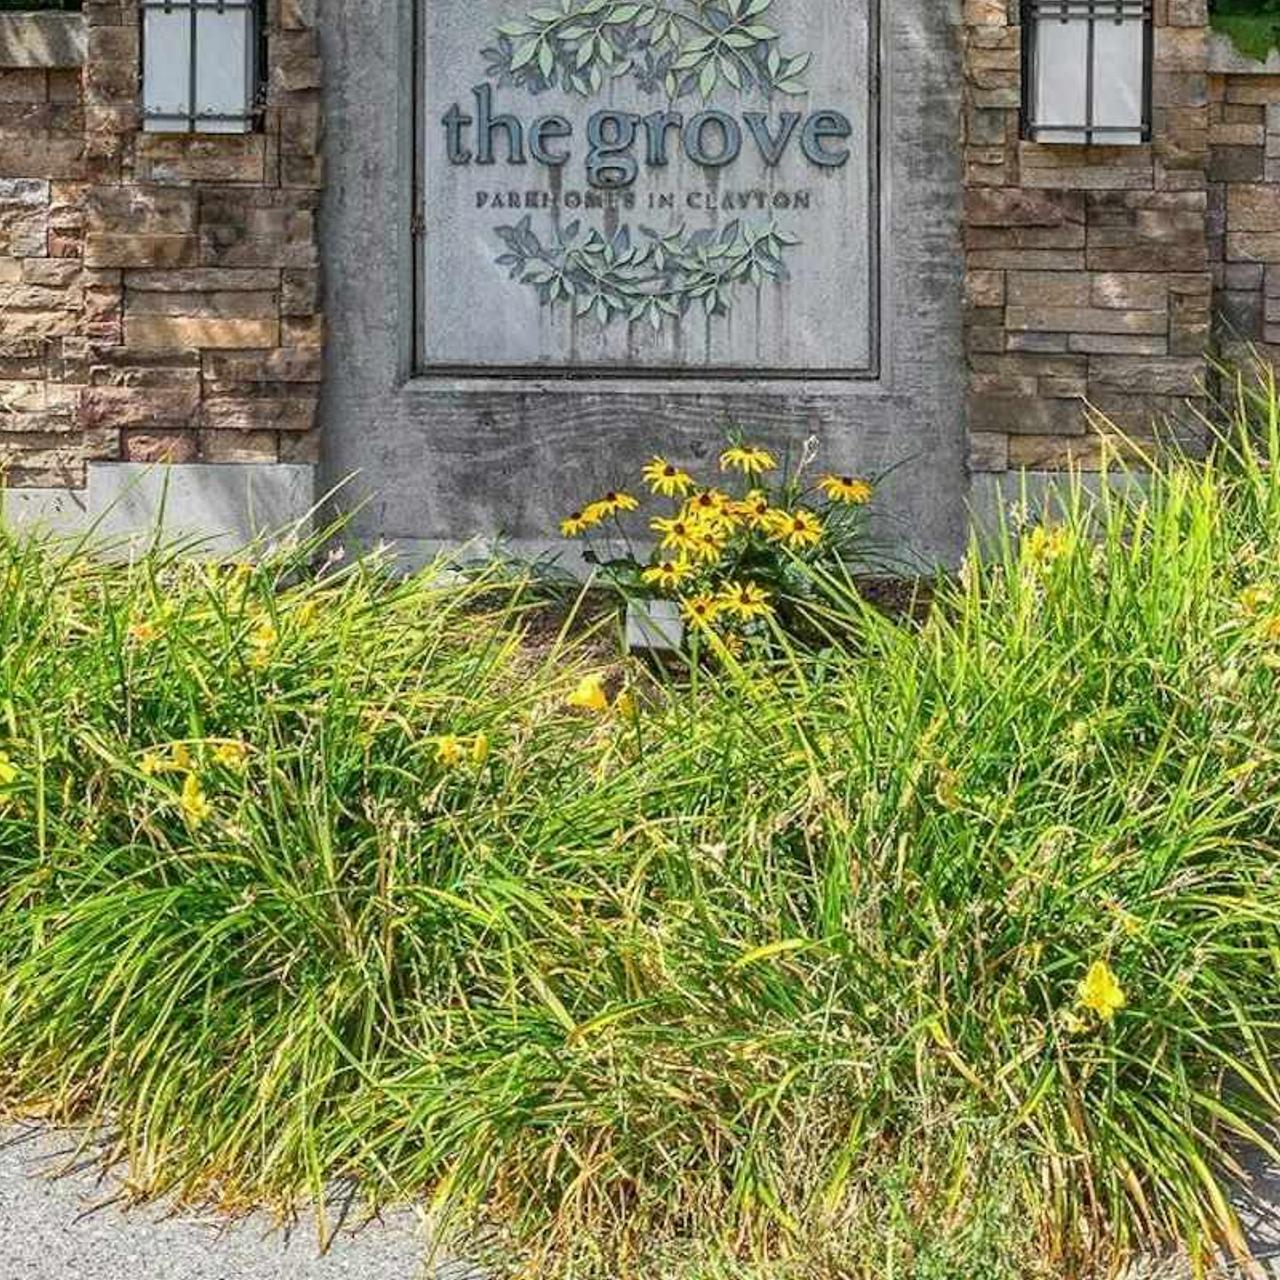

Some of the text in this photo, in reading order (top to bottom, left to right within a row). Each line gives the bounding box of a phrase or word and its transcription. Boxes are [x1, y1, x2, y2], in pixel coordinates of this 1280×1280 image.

[440, 83, 853, 188] the grove
[648, 190, 675, 208] IN
[686, 190, 812, 209] CLAYTON
